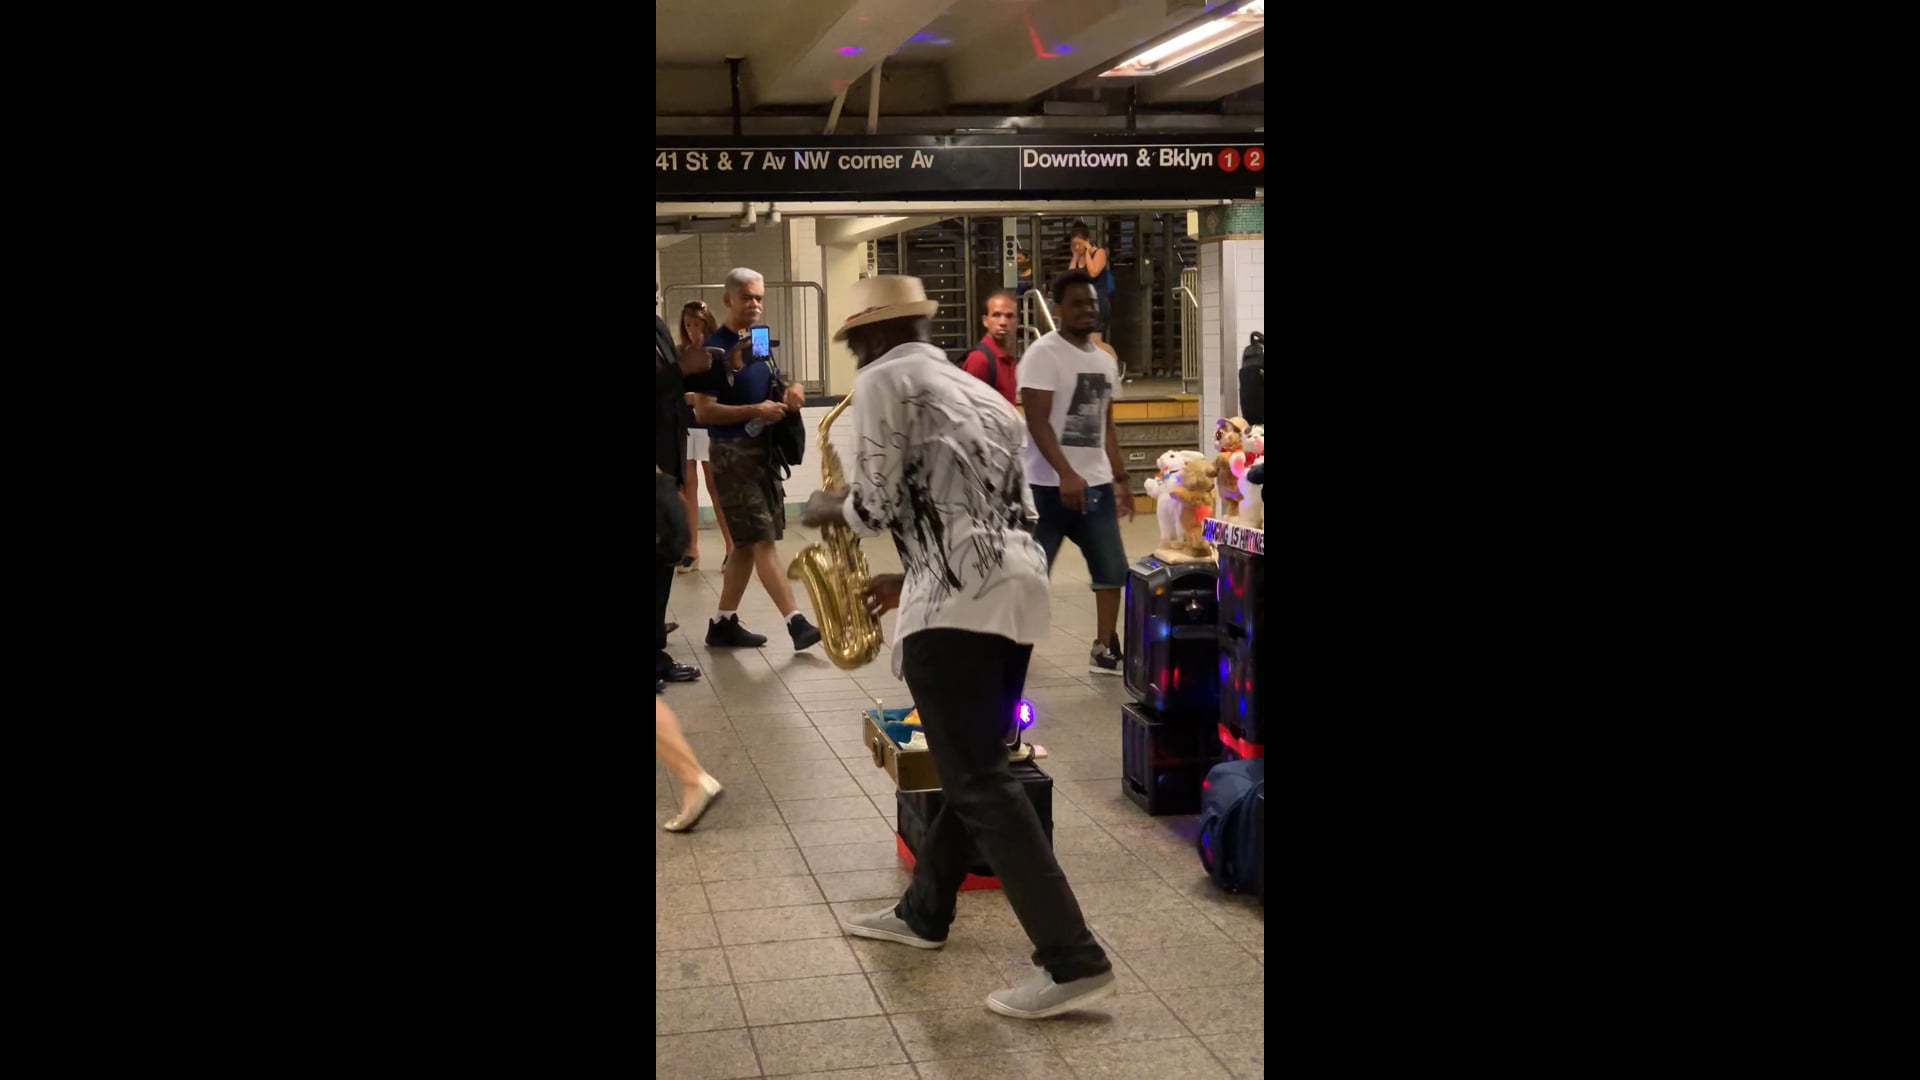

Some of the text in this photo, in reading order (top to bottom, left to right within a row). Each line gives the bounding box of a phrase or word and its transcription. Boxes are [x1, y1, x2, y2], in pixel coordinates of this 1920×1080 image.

[656, 149, 935, 171] 41 St & 7 Av NW corner Av
[1023, 149, 1128, 168] Downtown
[1136, 148, 1151, 168] &
[1159, 147, 1213, 171] Bklyn
[1250, 152, 1260, 167] 2
[1231, 526, 1240, 546] IS
